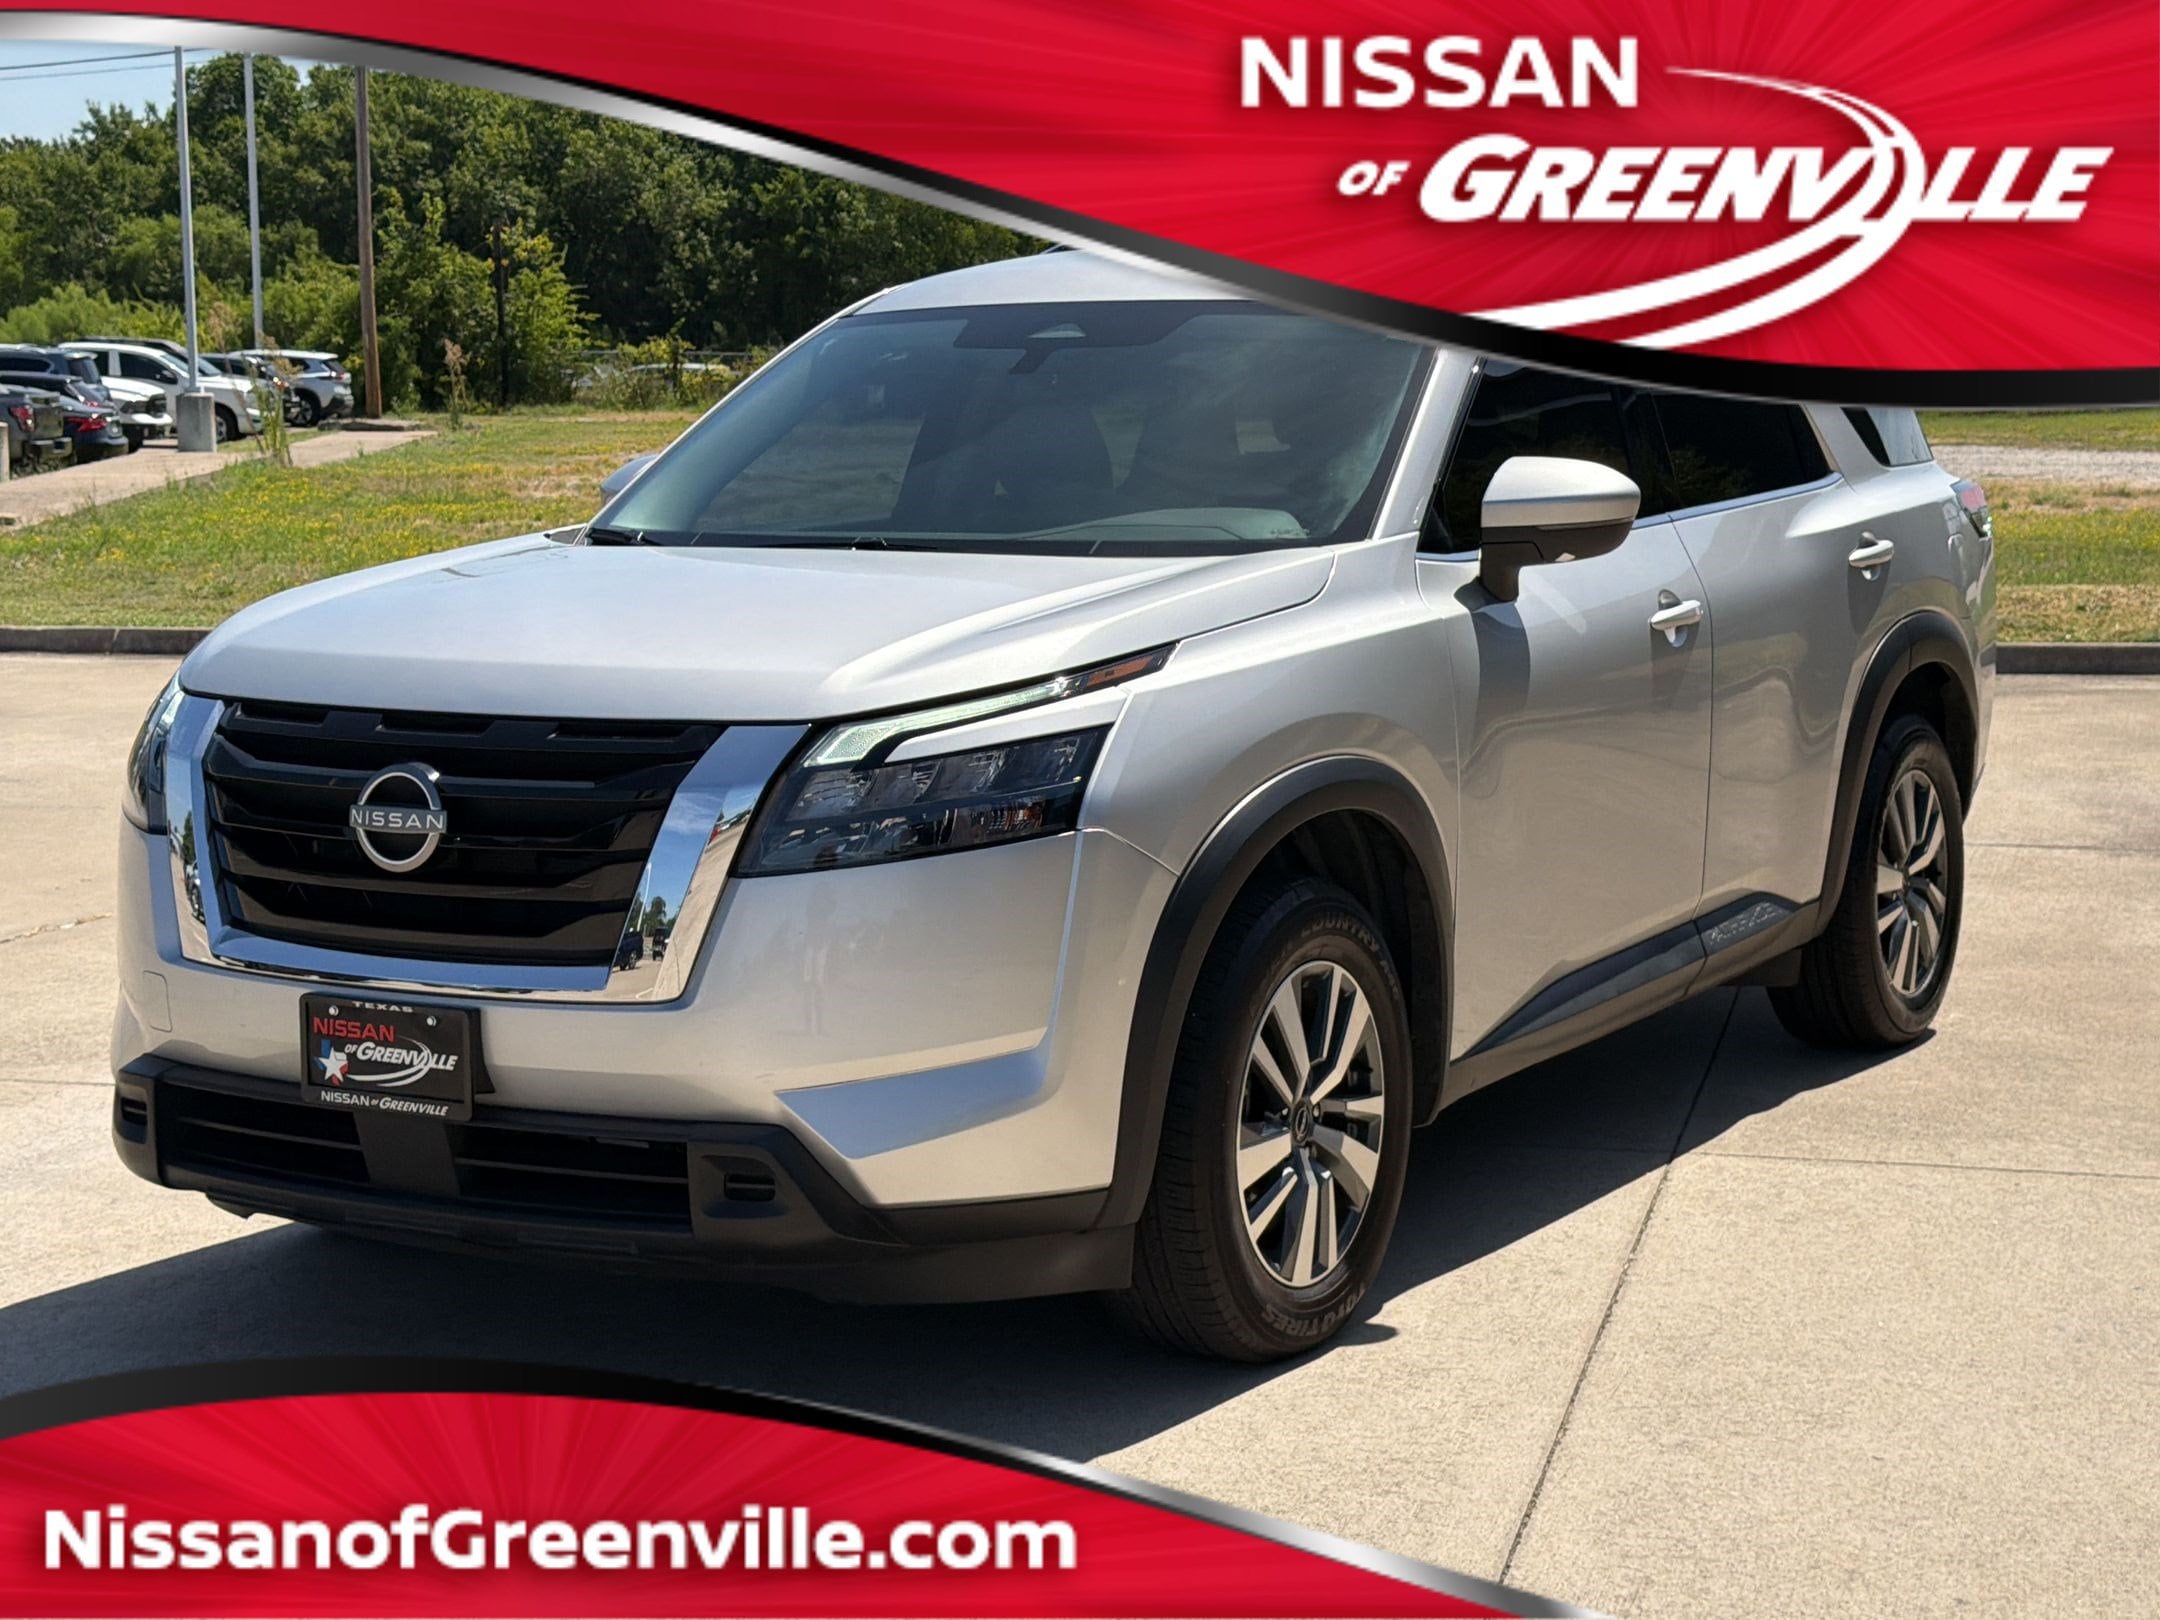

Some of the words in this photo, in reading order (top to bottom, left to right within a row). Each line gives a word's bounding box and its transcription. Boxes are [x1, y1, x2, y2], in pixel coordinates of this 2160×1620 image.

[351, 808, 443, 828] NISSAN
[352, 1001, 413, 1013] TEXAS
[313, 1017, 395, 1042] NISSAN
[344, 1043, 357, 1054] OF
[357, 1042, 458, 1071] GREENVILLE
[321, 1090, 370, 1107] NISSAN
[379, 1097, 448, 1116] GREENVILLE
